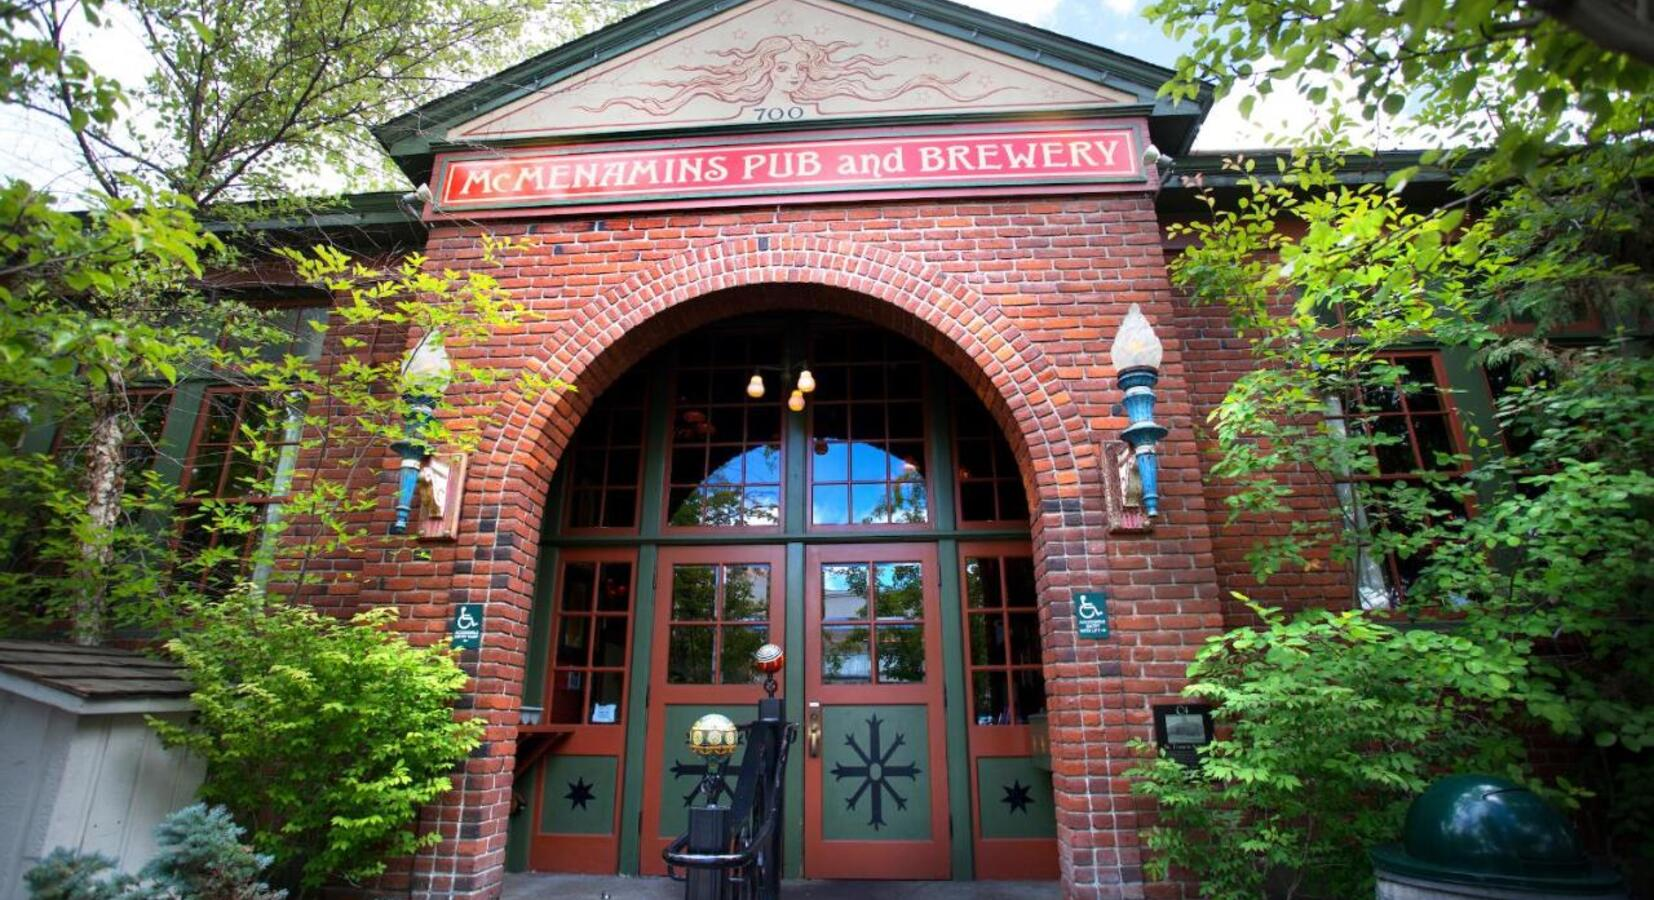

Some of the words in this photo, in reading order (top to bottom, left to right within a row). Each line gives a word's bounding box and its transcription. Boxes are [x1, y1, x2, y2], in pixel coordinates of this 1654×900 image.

[753, 106, 804, 121] 700
[460, 155, 728, 195] McMENAMINS
[742, 151, 822, 180] PUB
[837, 144, 906, 178] and
[919, 140, 1120, 173] BREWERY
